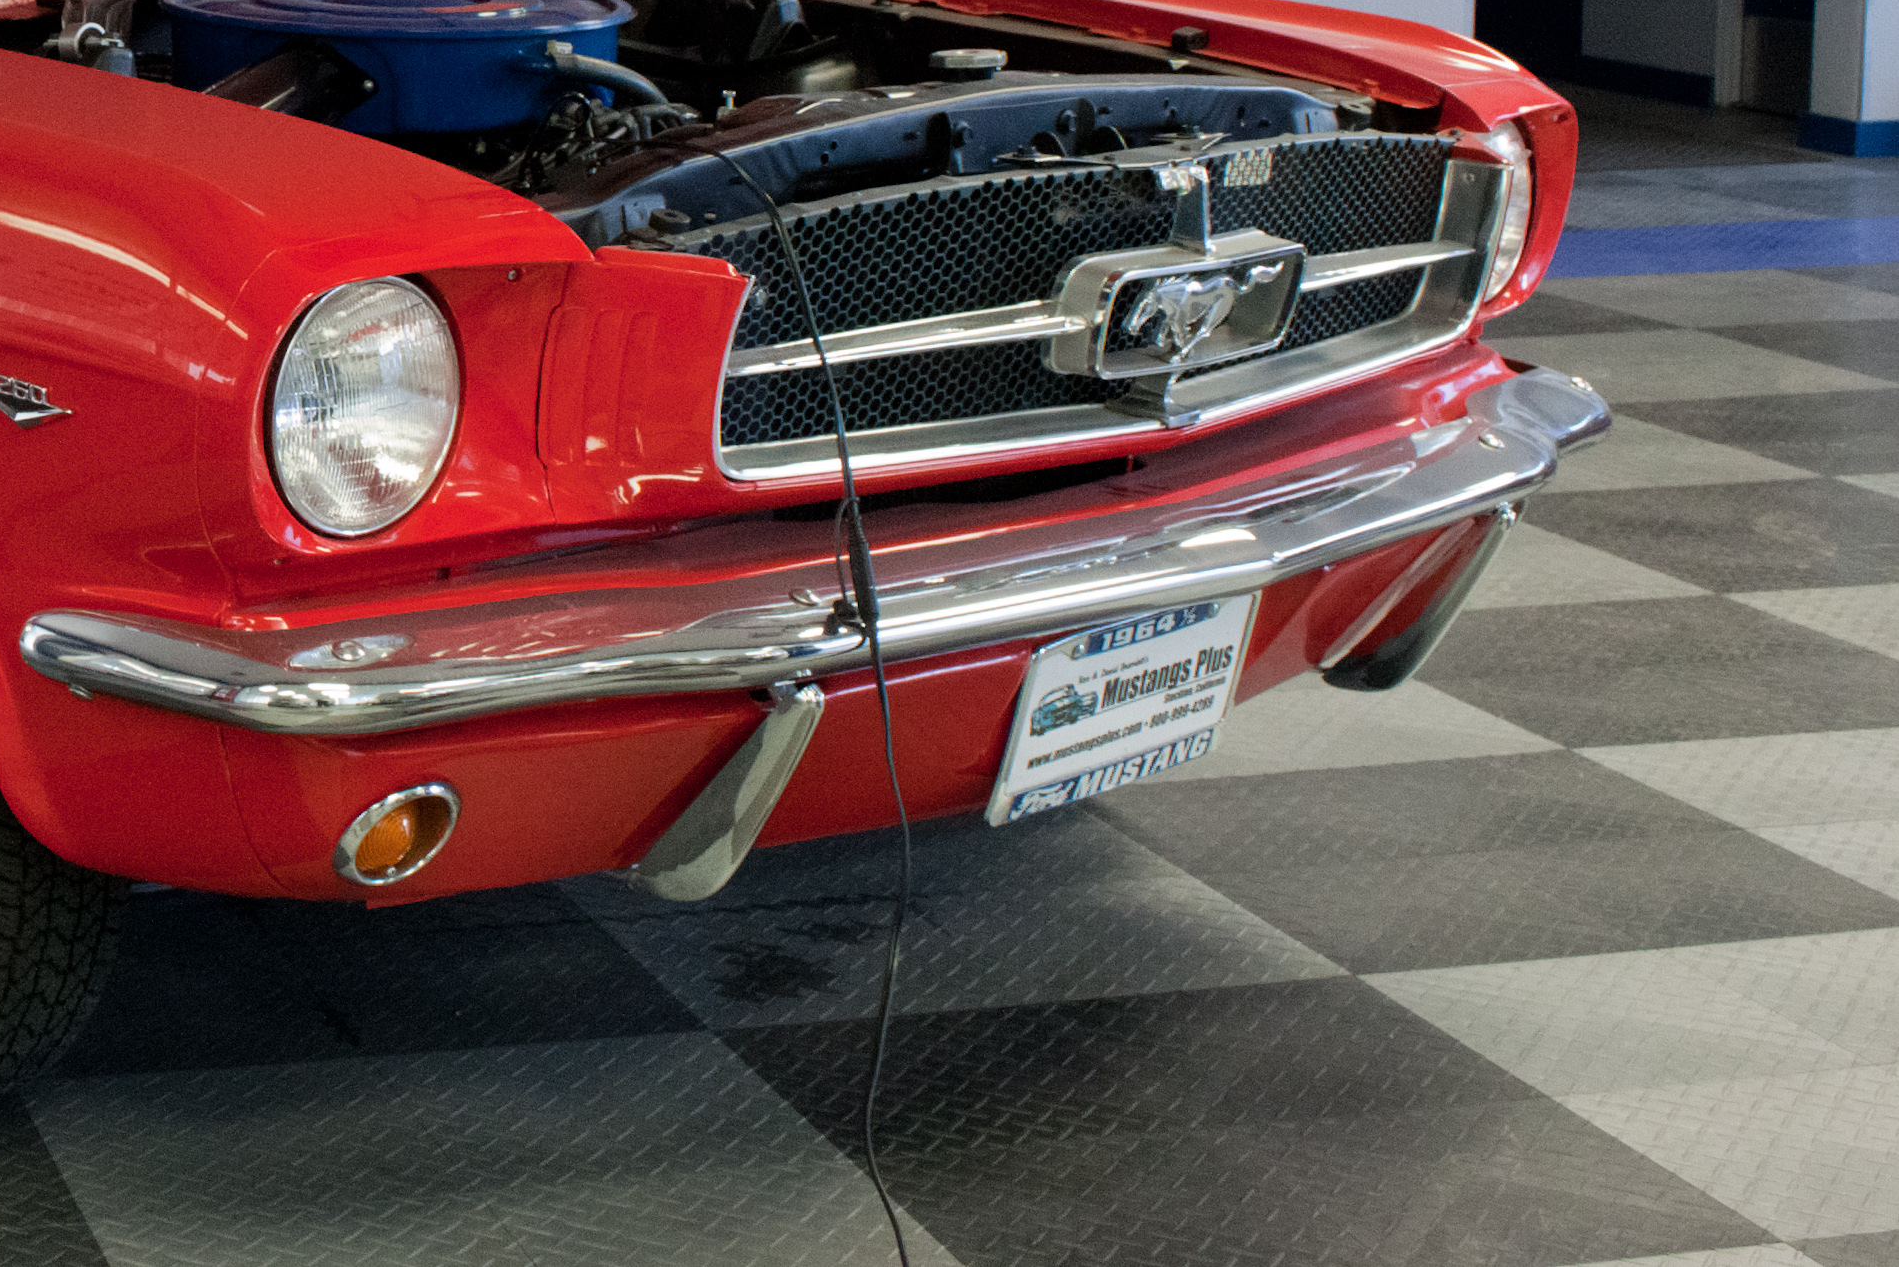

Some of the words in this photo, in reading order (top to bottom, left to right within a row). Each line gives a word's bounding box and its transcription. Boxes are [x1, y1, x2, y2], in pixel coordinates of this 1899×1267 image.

[1102, 613, 1176, 649] 1964
[1100, 658, 1193, 709] Mustangs
[1193, 645, 1234, 678] Plus
[1072, 730, 1213, 801] MUSTANG
